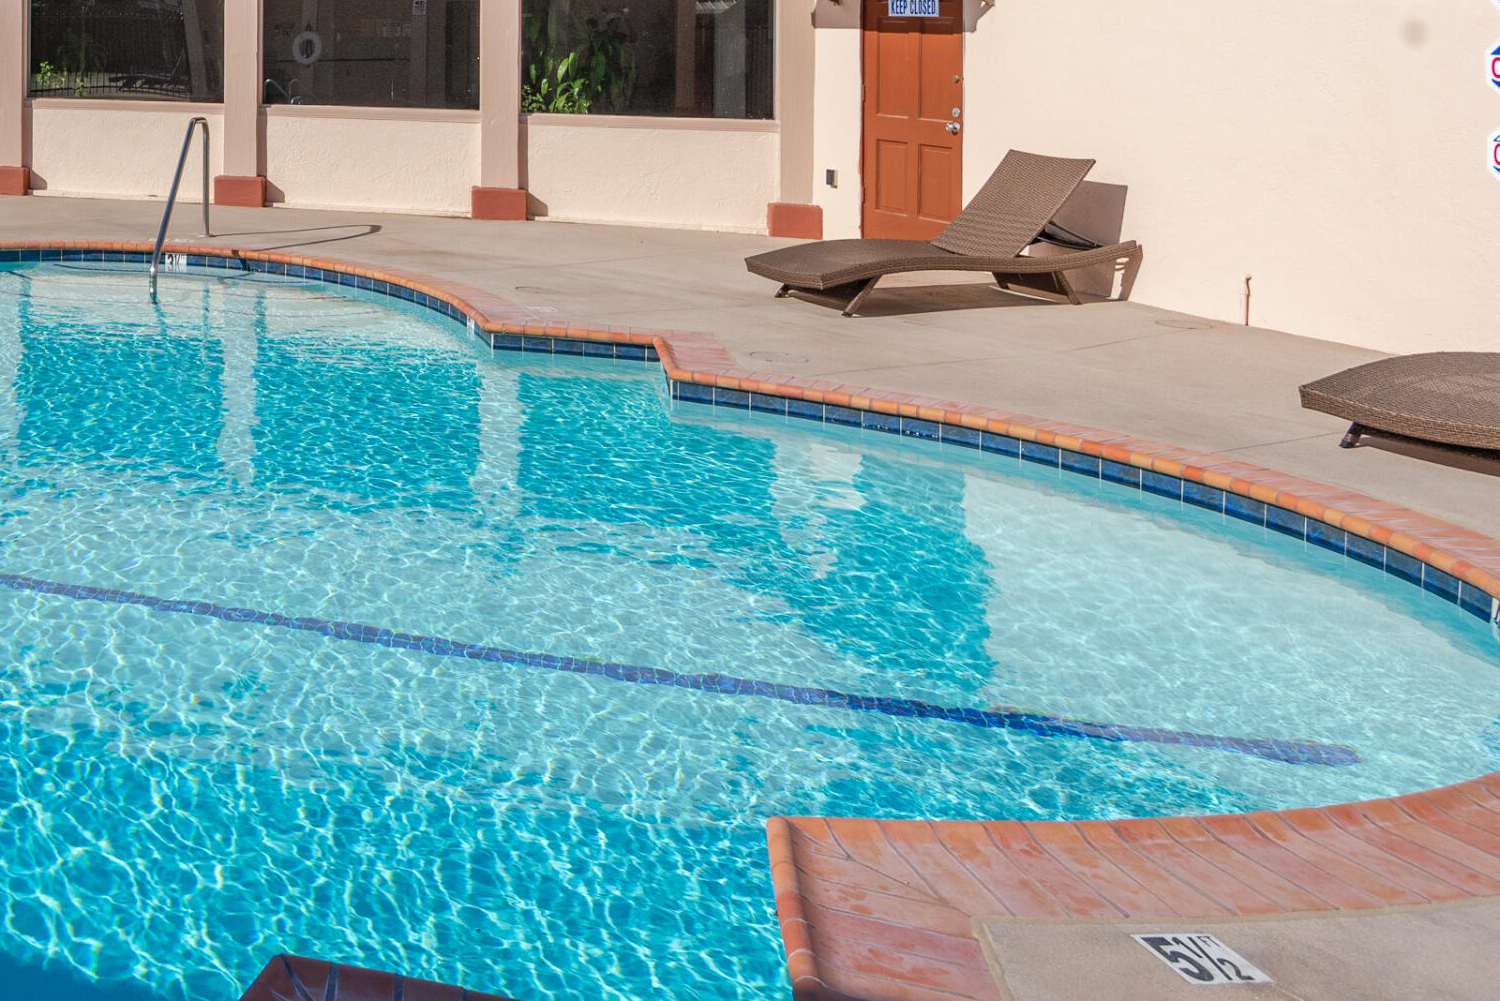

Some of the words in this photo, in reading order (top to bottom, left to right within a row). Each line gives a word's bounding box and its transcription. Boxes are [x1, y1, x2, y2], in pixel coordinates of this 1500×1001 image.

[890, 0, 908, 15] KEEP
[909, 0, 936, 15] CLOSED
[1196, 935, 1221, 948] FT
